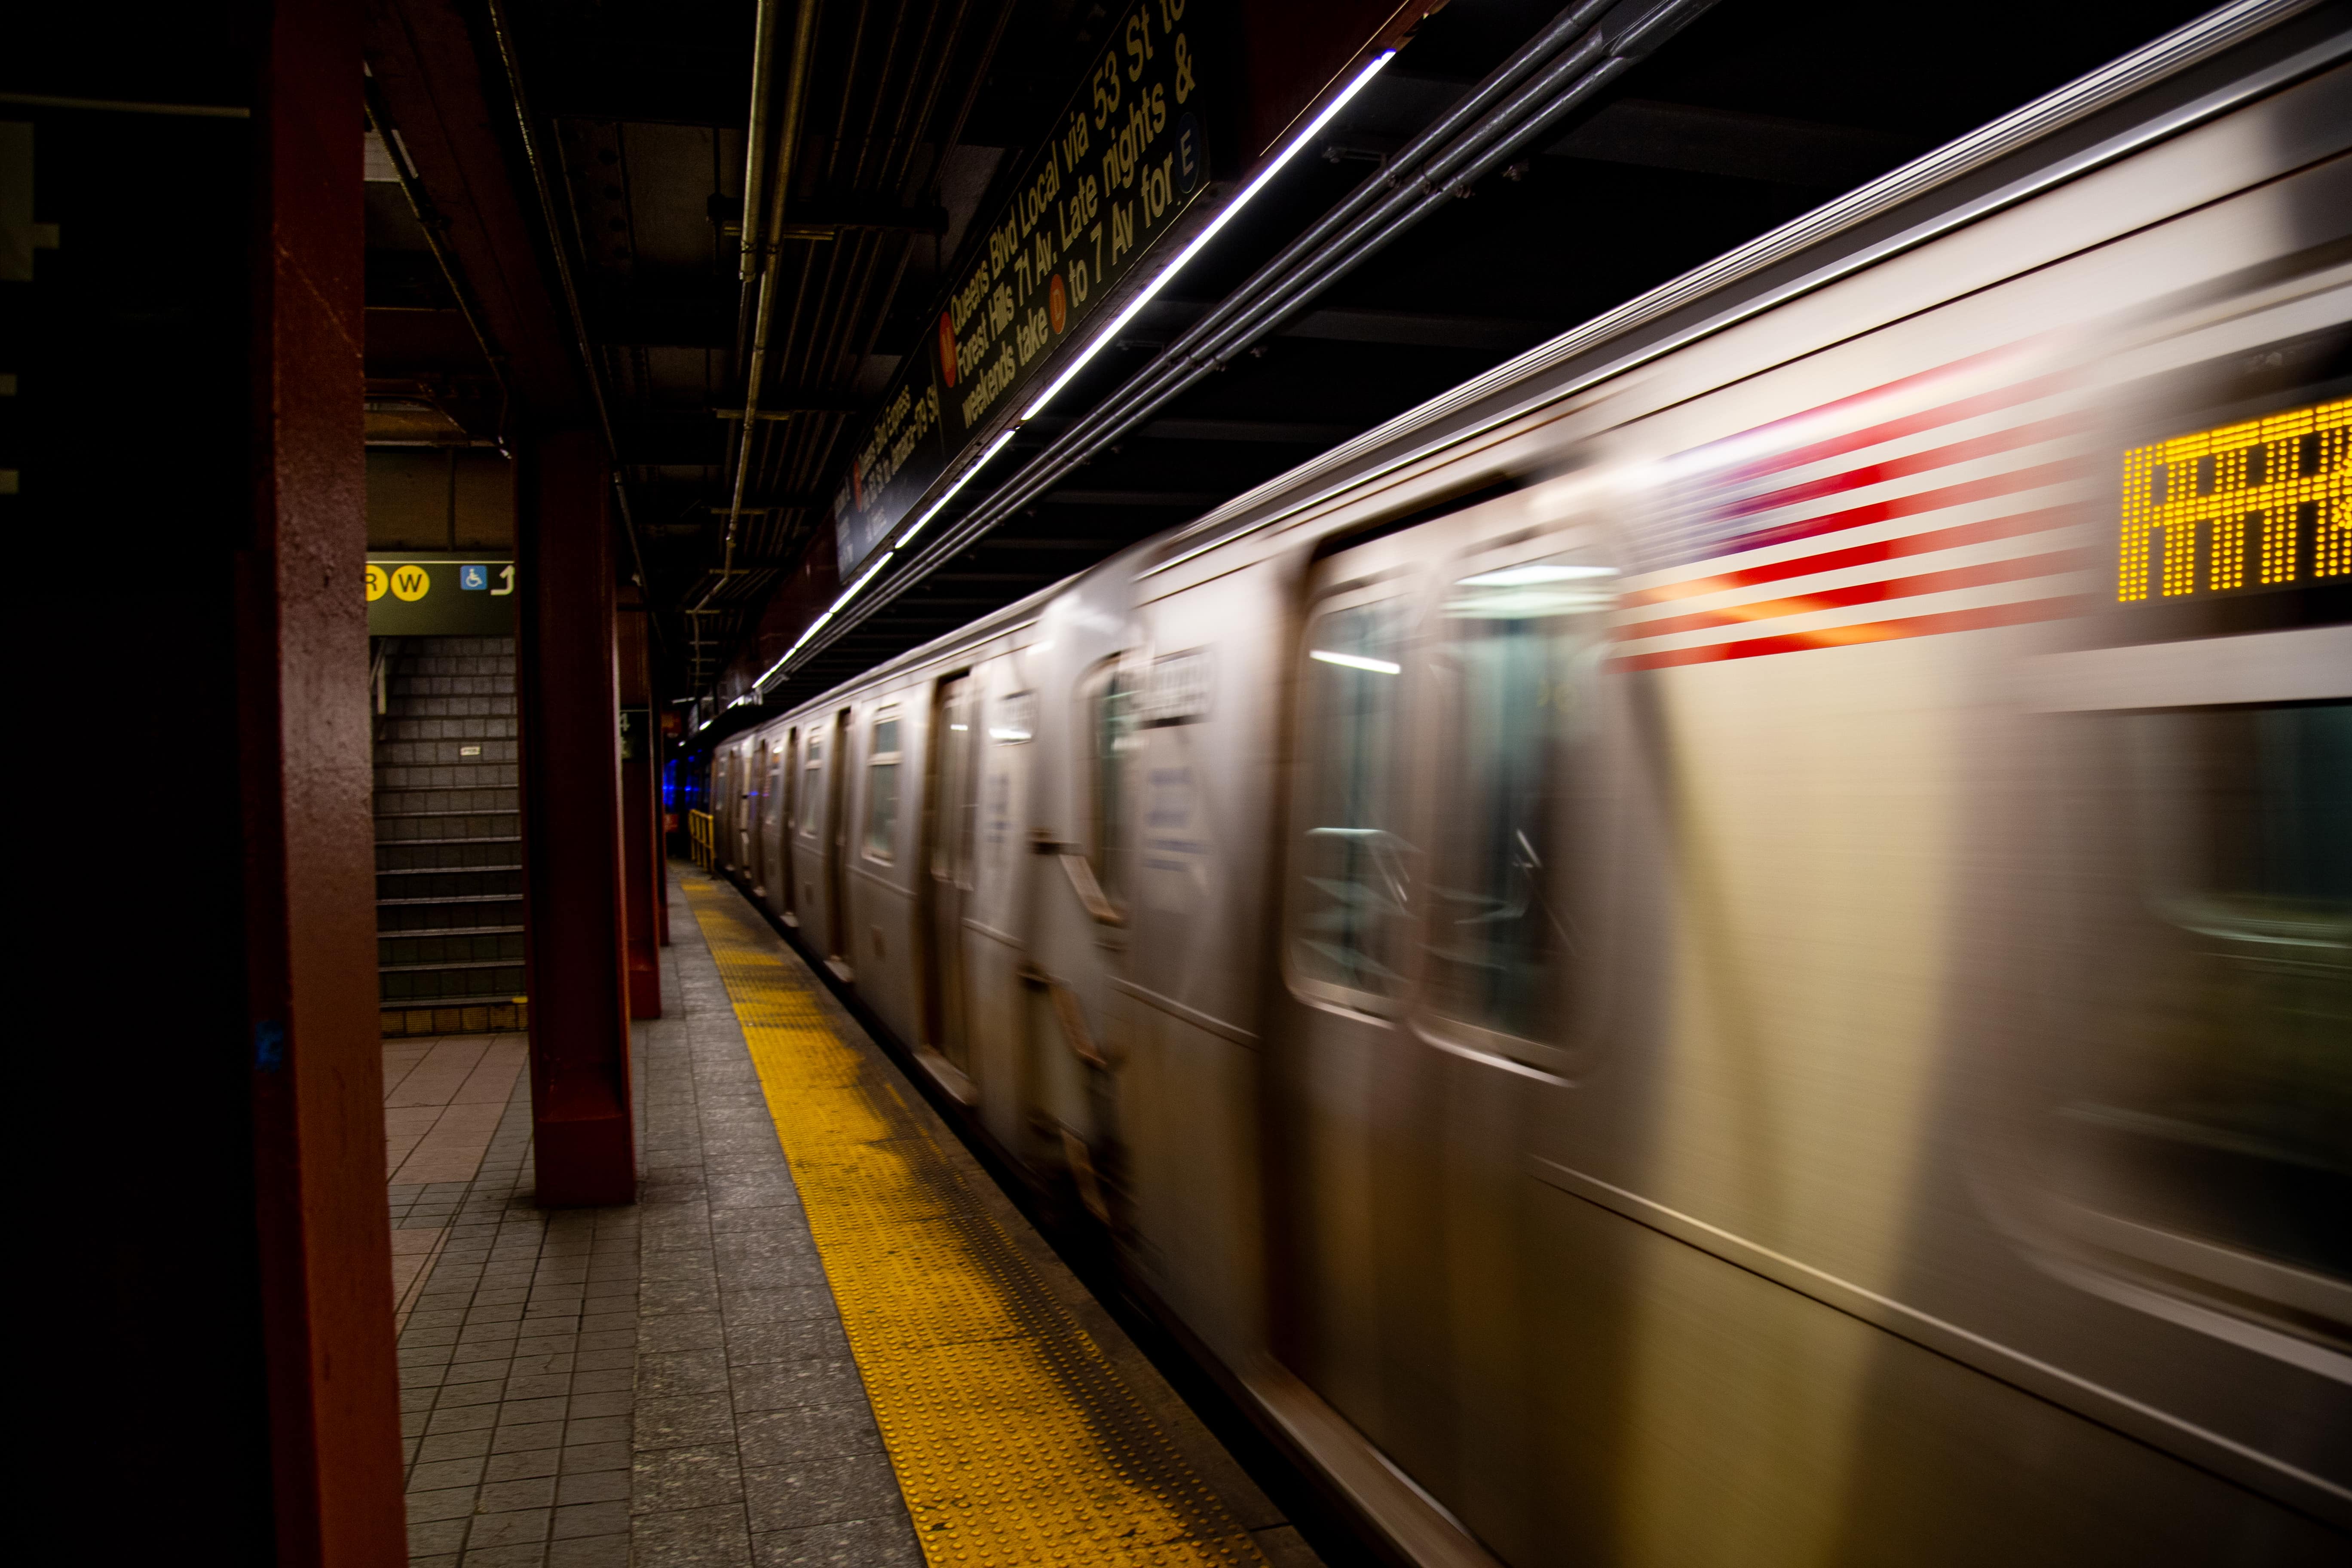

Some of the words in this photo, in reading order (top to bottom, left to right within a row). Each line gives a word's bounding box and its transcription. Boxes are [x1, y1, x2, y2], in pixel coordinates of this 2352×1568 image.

[951, 260, 989, 336] Queens
[989, 205, 1018, 280] Blvd
[1018, 140, 1060, 237] Local
[1063, 110, 1089, 173] via
[1093, 50, 1120, 130] 53
[1126, 3, 1153, 82] St
[956, 311, 989, 384] Forest
[989, 282, 1014, 341] Hills
[1014, 248, 1033, 307] 71
[1036, 231, 1058, 286] Av.
[1059, 174, 1099, 253] Late
[1102, 83, 1166, 198] nights
[1175, 33, 1196, 104] &
[962, 340, 1016, 429] weekends
[1016, 306, 1049, 367] take
[1069, 259, 1088, 308] to
[1090, 220, 1102, 284] 7
[1112, 200, 1134, 266] Av
[1141, 151, 1173, 229] for
[1180, 129, 1194, 177] E
[365, 573, 377, 591] R
[398, 574, 423, 592] W
